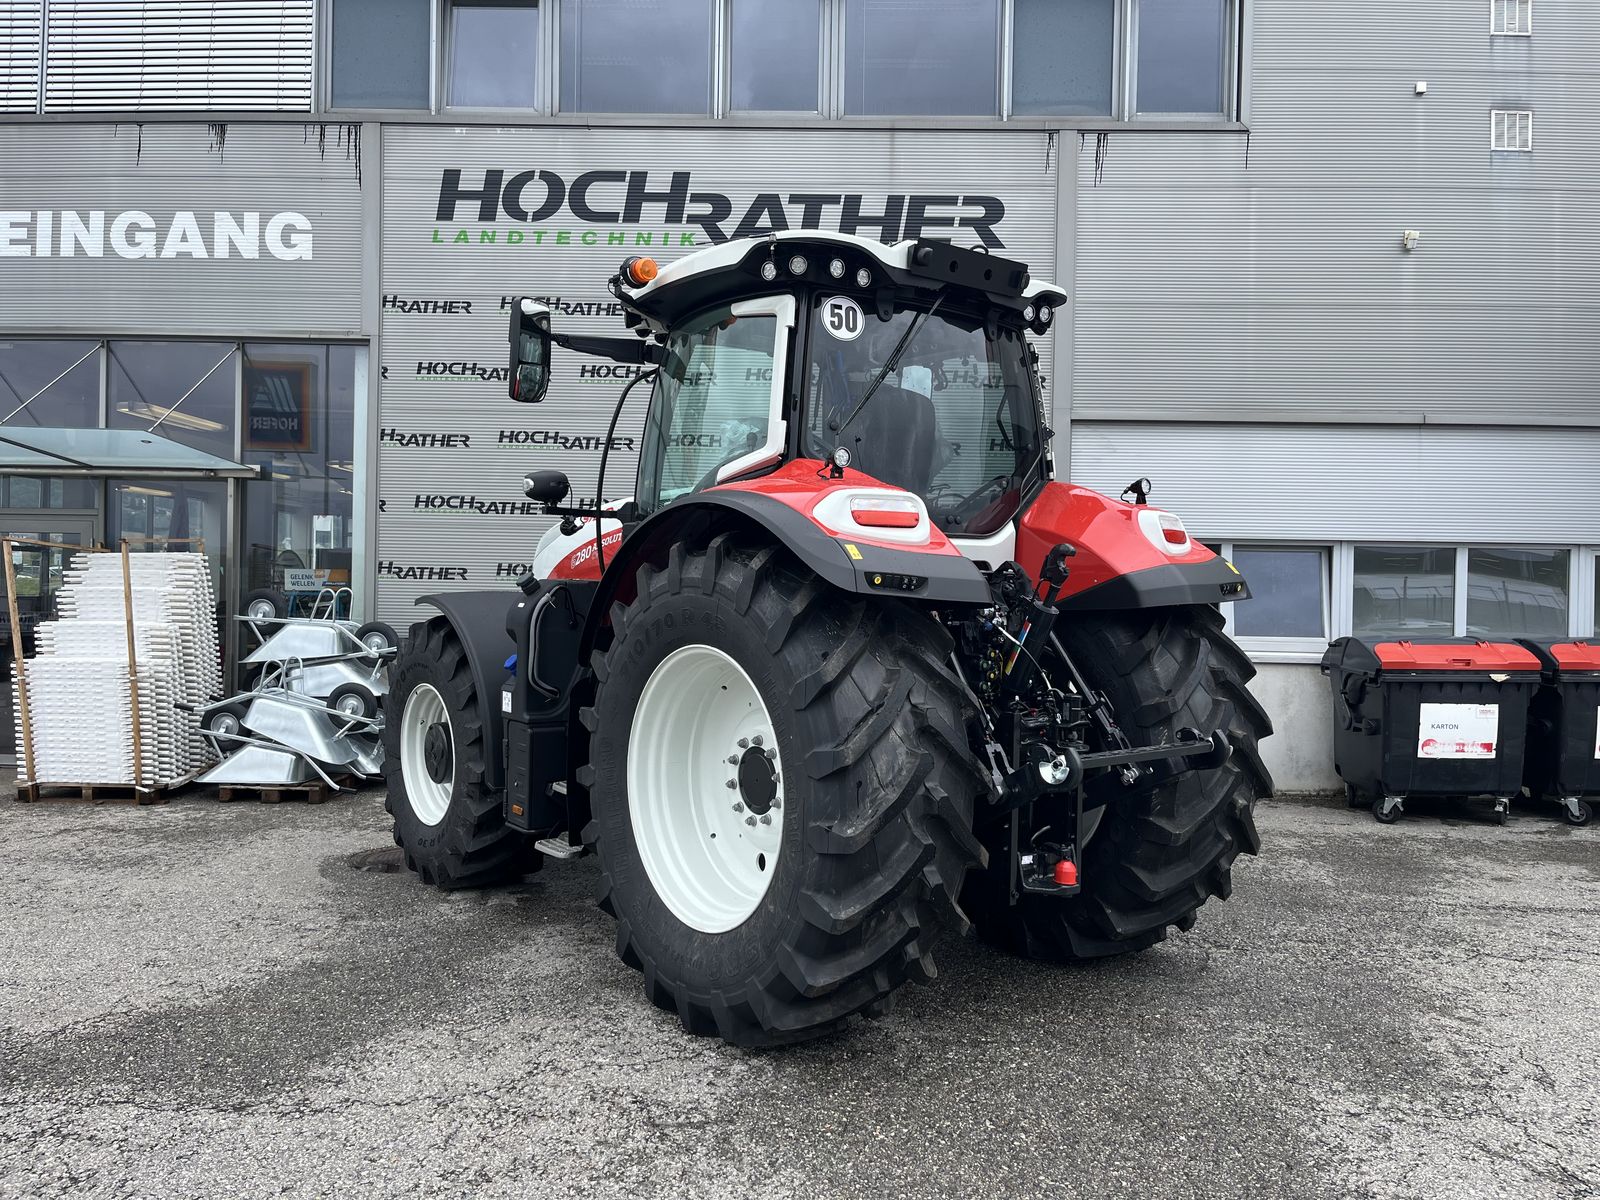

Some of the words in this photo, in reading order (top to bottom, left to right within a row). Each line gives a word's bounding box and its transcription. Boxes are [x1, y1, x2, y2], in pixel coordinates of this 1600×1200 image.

[0, 210, 313, 261] EINGANG
[431, 229, 697, 247] LANDTECHNIK
[829, 303, 858, 333] 50
[591, 532, 622, 552] ASOLUT
[290, 573, 314, 581] GELENK
